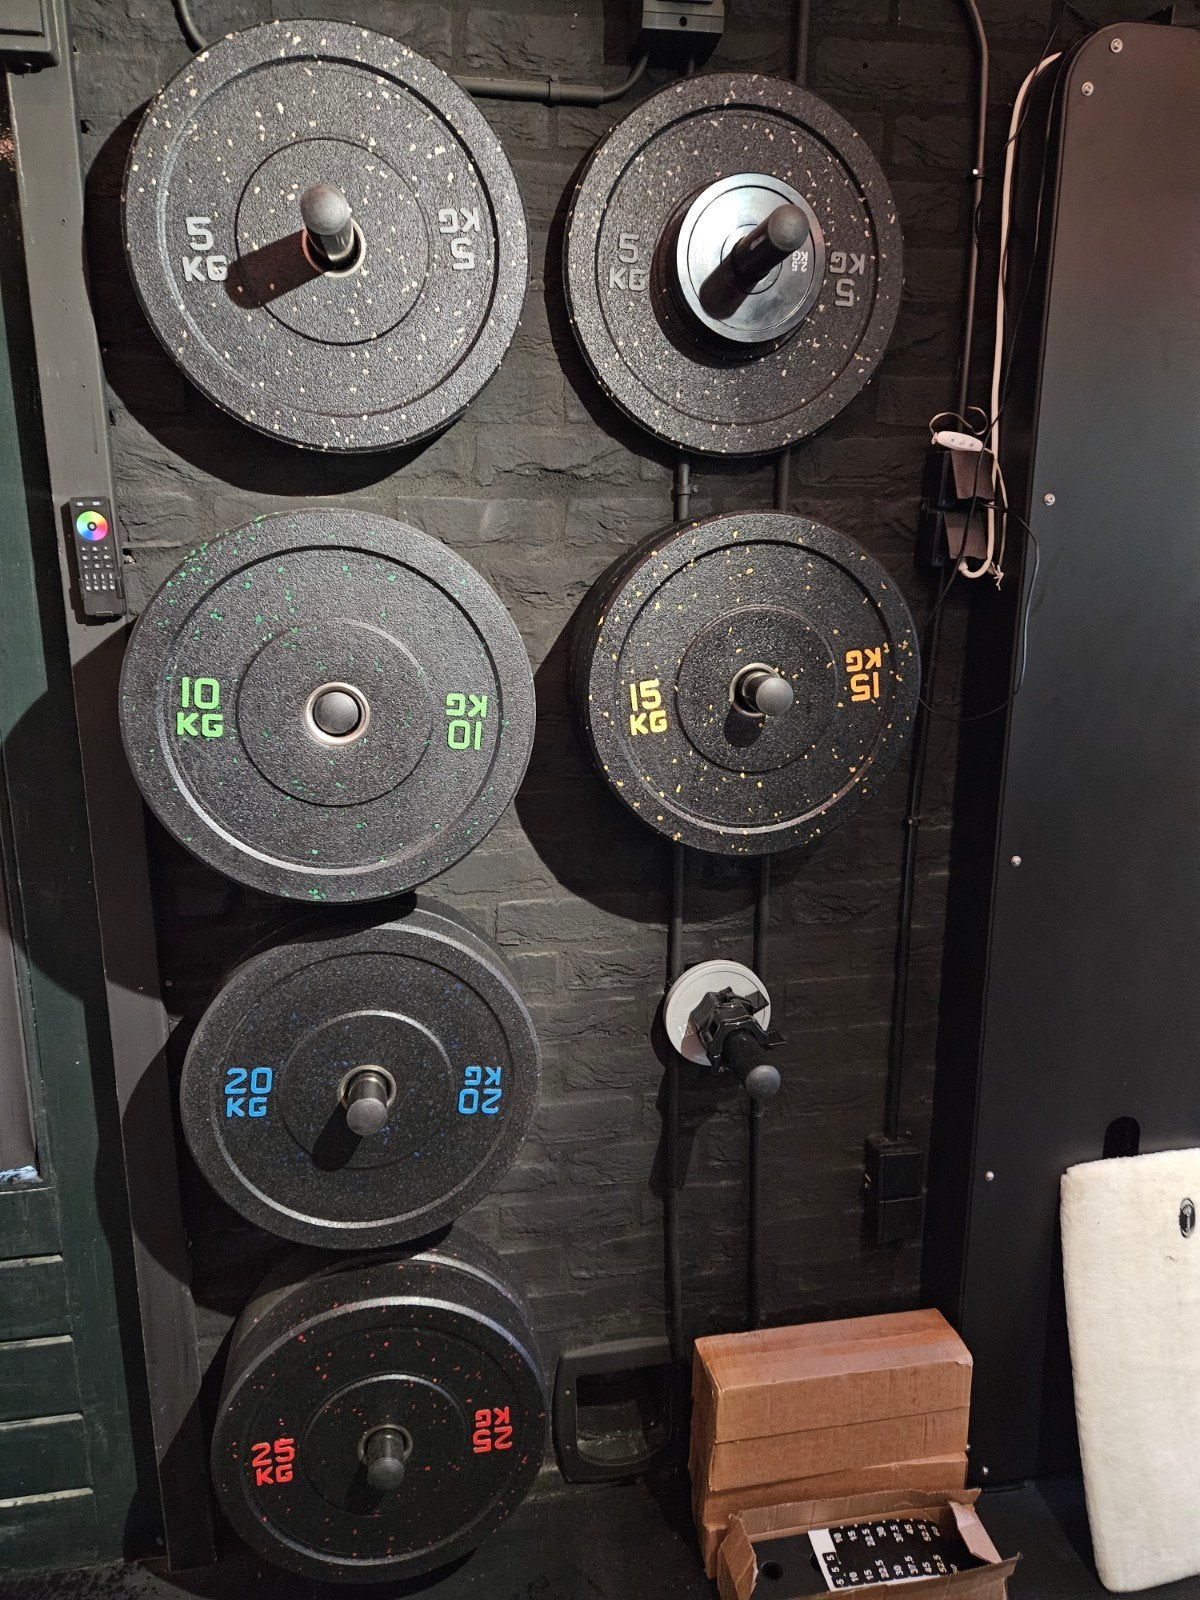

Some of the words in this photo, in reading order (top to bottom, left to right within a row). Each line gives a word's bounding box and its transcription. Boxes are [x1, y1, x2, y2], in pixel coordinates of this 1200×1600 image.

[186, 216, 215, 251] 5
[438, 207, 481, 234] KG
[451, 237, 475, 270] 5
[619, 232, 640, 263] 5
[791, 251, 808, 261] KG
[182, 255, 229, 282] KG
[791, 260, 808, 272] 2.5
[829, 251, 866, 275] KG
[609, 267, 648, 291] KG
[834, 278, 855, 307] 5
[845, 647, 882, 673] KG
[181, 676, 220, 710] 10
[629, 678, 662, 712] 15
[850, 671, 880, 701] 15
[445, 693, 488, 718] KG
[176, 712, 224, 738] KG
[447, 719, 482, 750] 10
[629, 710, 668, 736] KG
[224, 1067, 273, 1095] 20
[464, 1066, 502, 1086] KG
[226, 1096, 268, 1118] KG
[458, 1088, 502, 1115] 20
[475, 1406, 510, 1428] KG
[472, 1425, 513, 1454] 25
[251, 1438, 295, 1468] 25
[256, 1464, 294, 1486] KG
[847, 1530, 857, 1541] 15
[917, 1524, 932, 1542] 52.5
[863, 1569, 874, 1581] 15
[893, 1564, 904, 1576] 30
[932, 1554, 947, 1573] 52.5
